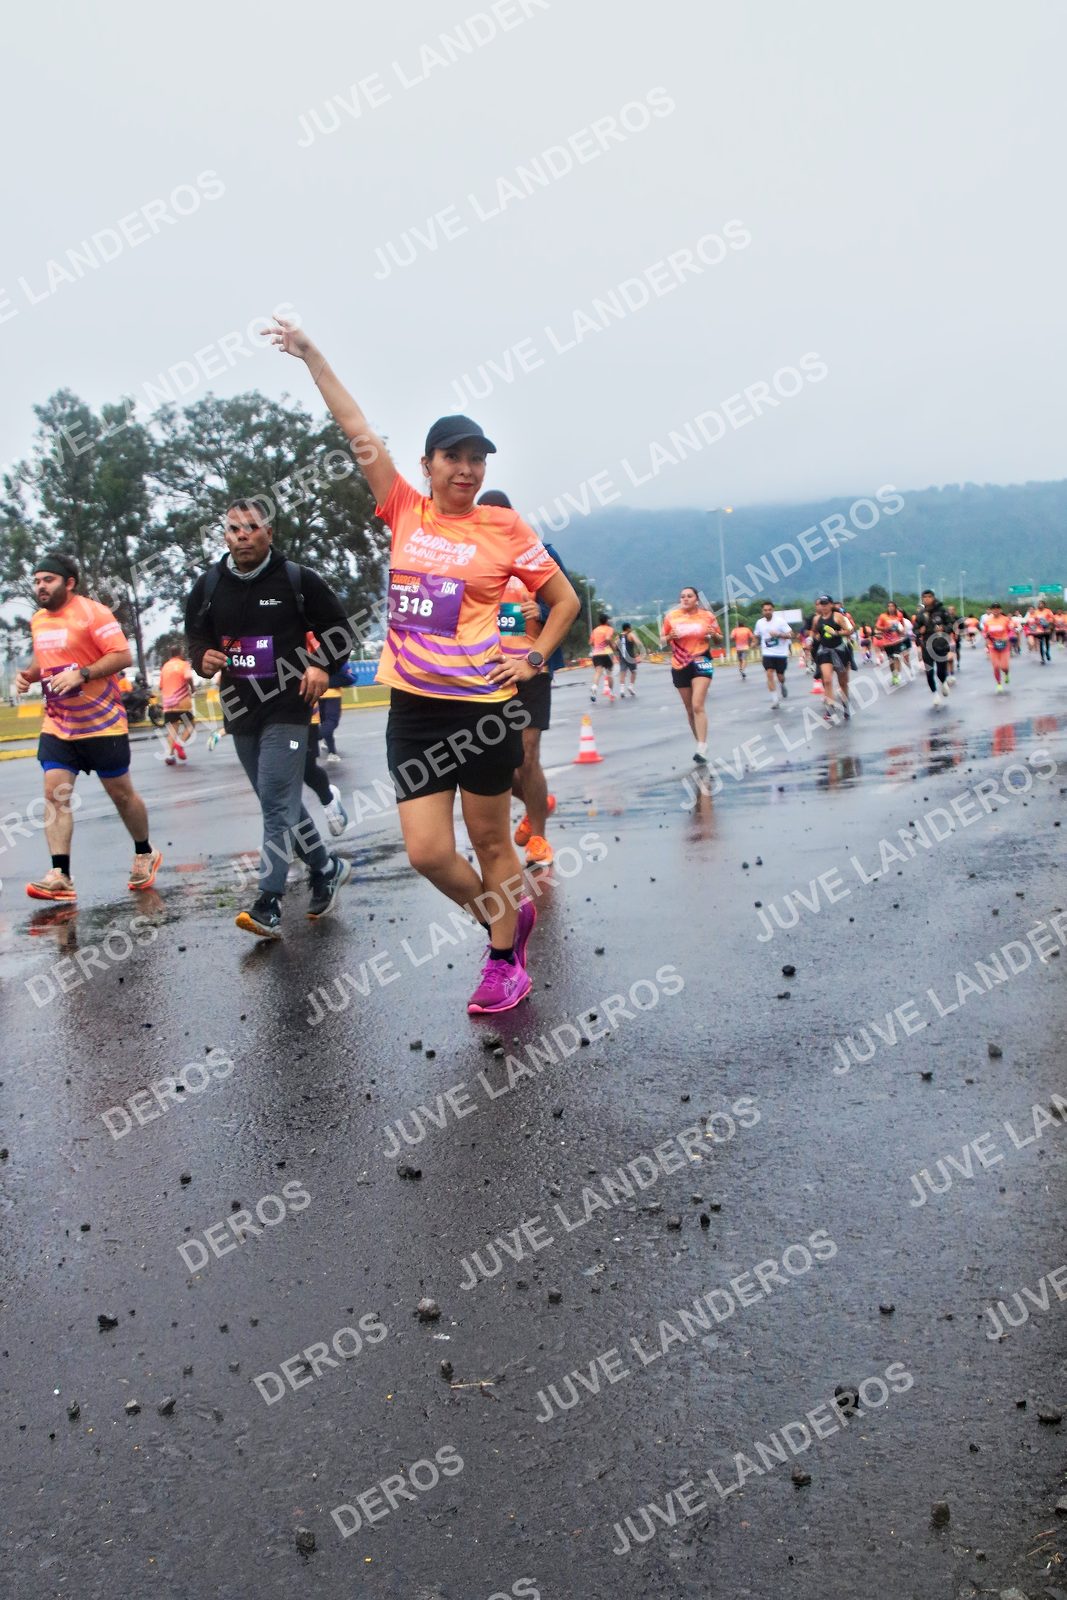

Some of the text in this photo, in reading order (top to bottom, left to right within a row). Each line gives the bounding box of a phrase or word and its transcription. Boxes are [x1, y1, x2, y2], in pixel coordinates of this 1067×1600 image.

[403, 543, 454, 563] OMNILIFE
[440, 581, 459, 595] 15K
[397, 595, 434, 617] 318
[256, 639, 269, 649] 15K
[232, 654, 256, 668] 648
